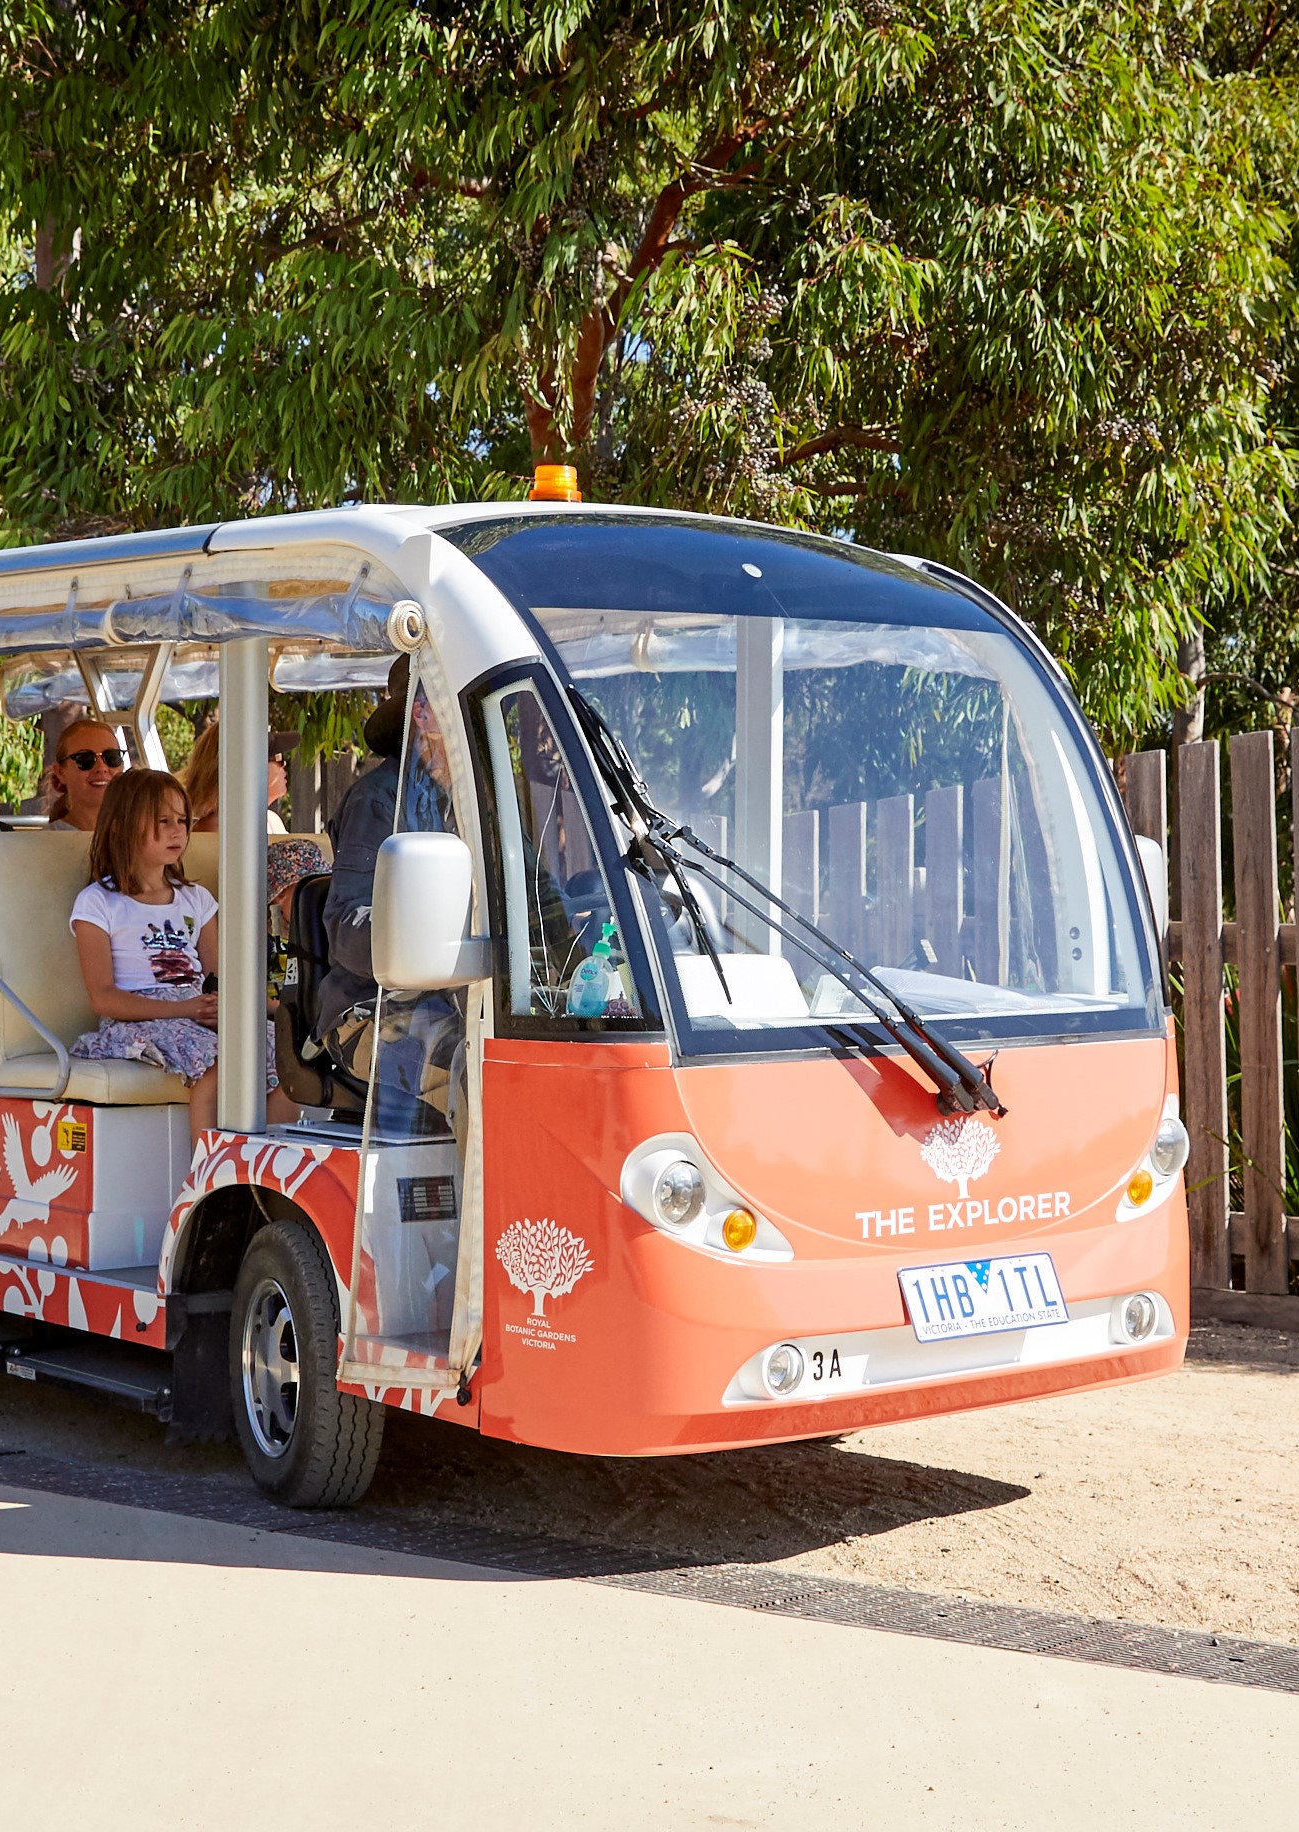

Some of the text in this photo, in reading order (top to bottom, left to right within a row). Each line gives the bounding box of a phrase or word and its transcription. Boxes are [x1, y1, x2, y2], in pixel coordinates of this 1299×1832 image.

[854, 1191, 1071, 1239] THE EXPLORER
[526, 1317, 551, 1329] ROYAL
[921, 1321, 962, 1335] VICTORIA
[970, 1318, 987, 1330] THE
[988, 1312, 1036, 1327] EDUCATION
[1037, 1308, 1061, 1320] STATE
[505, 1324, 577, 1343] BOTANIC GARDENS
[521, 1337, 556, 1350] VICTORIA
[812, 1348, 842, 1381] 3A
